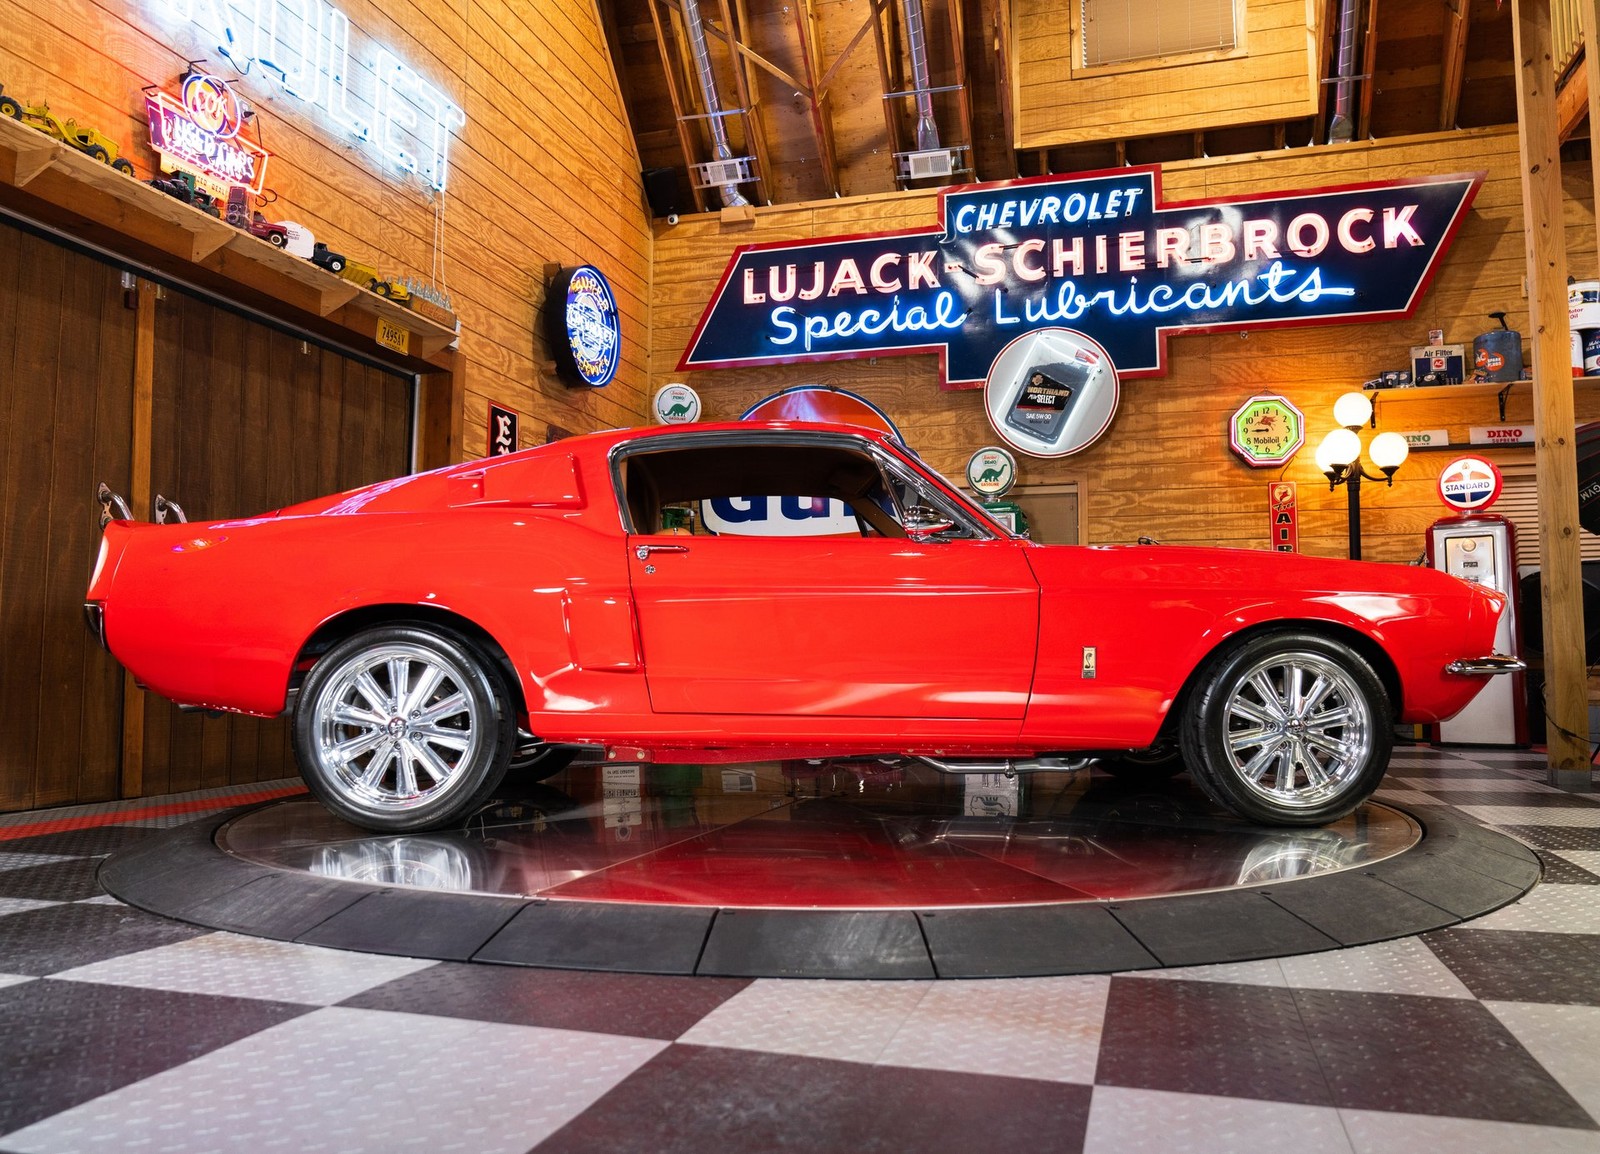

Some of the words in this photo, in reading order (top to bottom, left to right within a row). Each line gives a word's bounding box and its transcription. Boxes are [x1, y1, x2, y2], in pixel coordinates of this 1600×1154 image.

[955, 187, 1143, 233] CHEVROLET
[769, 291, 970, 351] Special
[994, 261, 1355, 325] Lubricants
[1435, 349, 1453, 357] Filter
[1036, 394, 1056, 404] SELECT
[1403, 434, 1431, 442] INO
[1486, 428, 1523, 438] DINO
[1246, 437, 1251, 445] 8
[1253, 437, 1280, 445] Mobiloil
[1445, 481, 1490, 492] STANDARD
